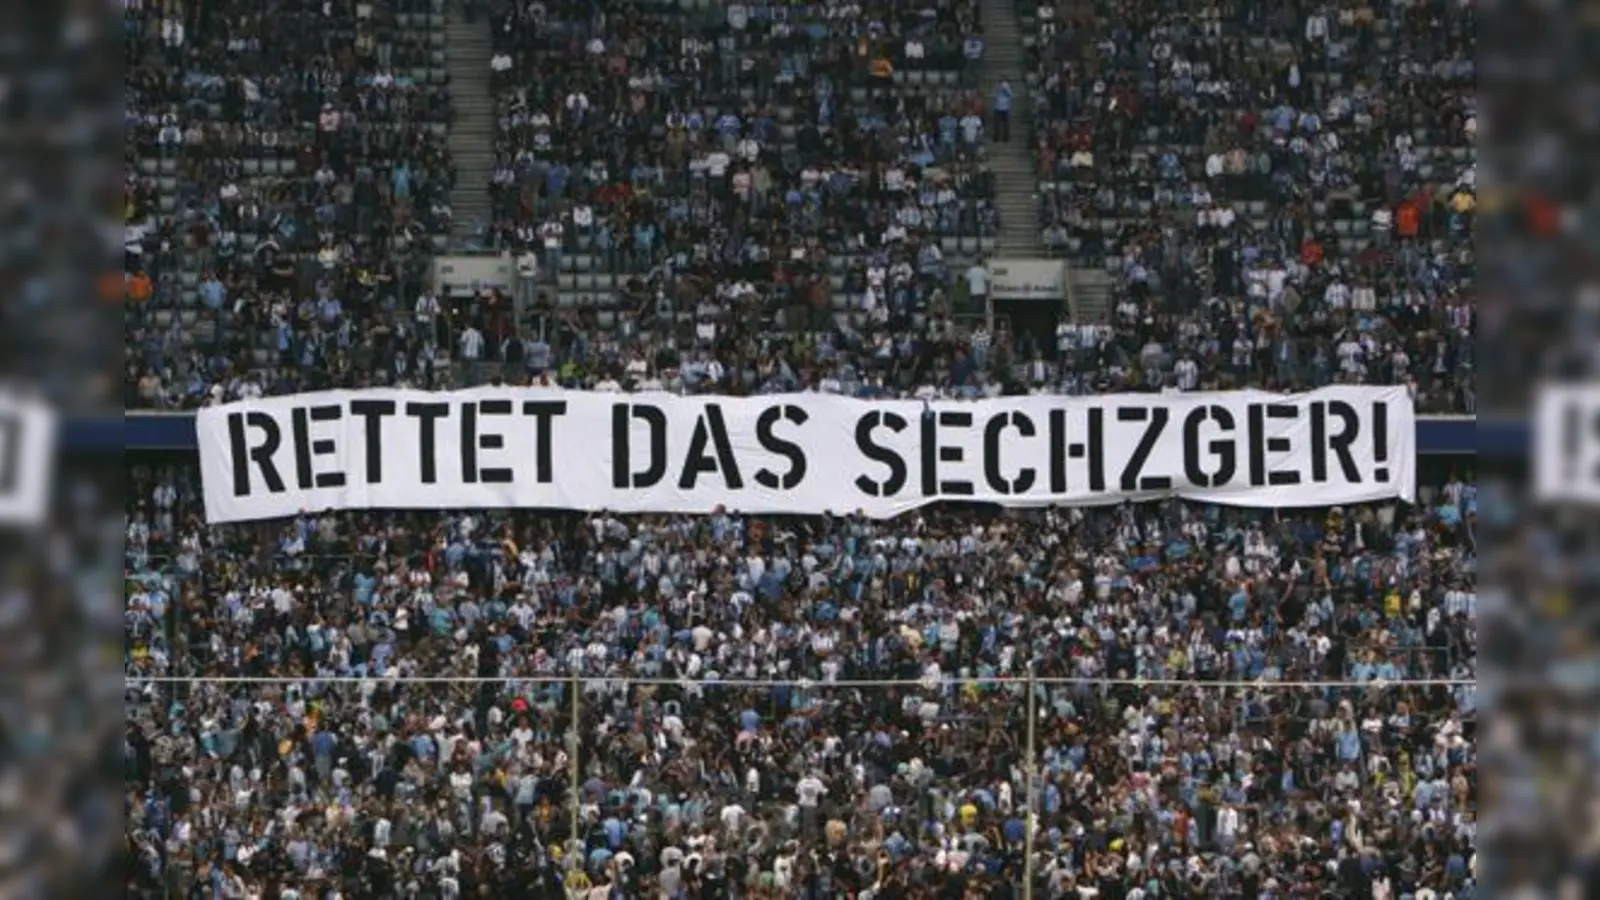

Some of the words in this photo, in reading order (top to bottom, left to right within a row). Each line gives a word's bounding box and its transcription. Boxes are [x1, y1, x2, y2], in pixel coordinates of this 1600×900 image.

[228, 400, 567, 497] RETTET
[612, 403, 809, 490] DAS
[854, 400, 1390, 497] SECHZGER!
